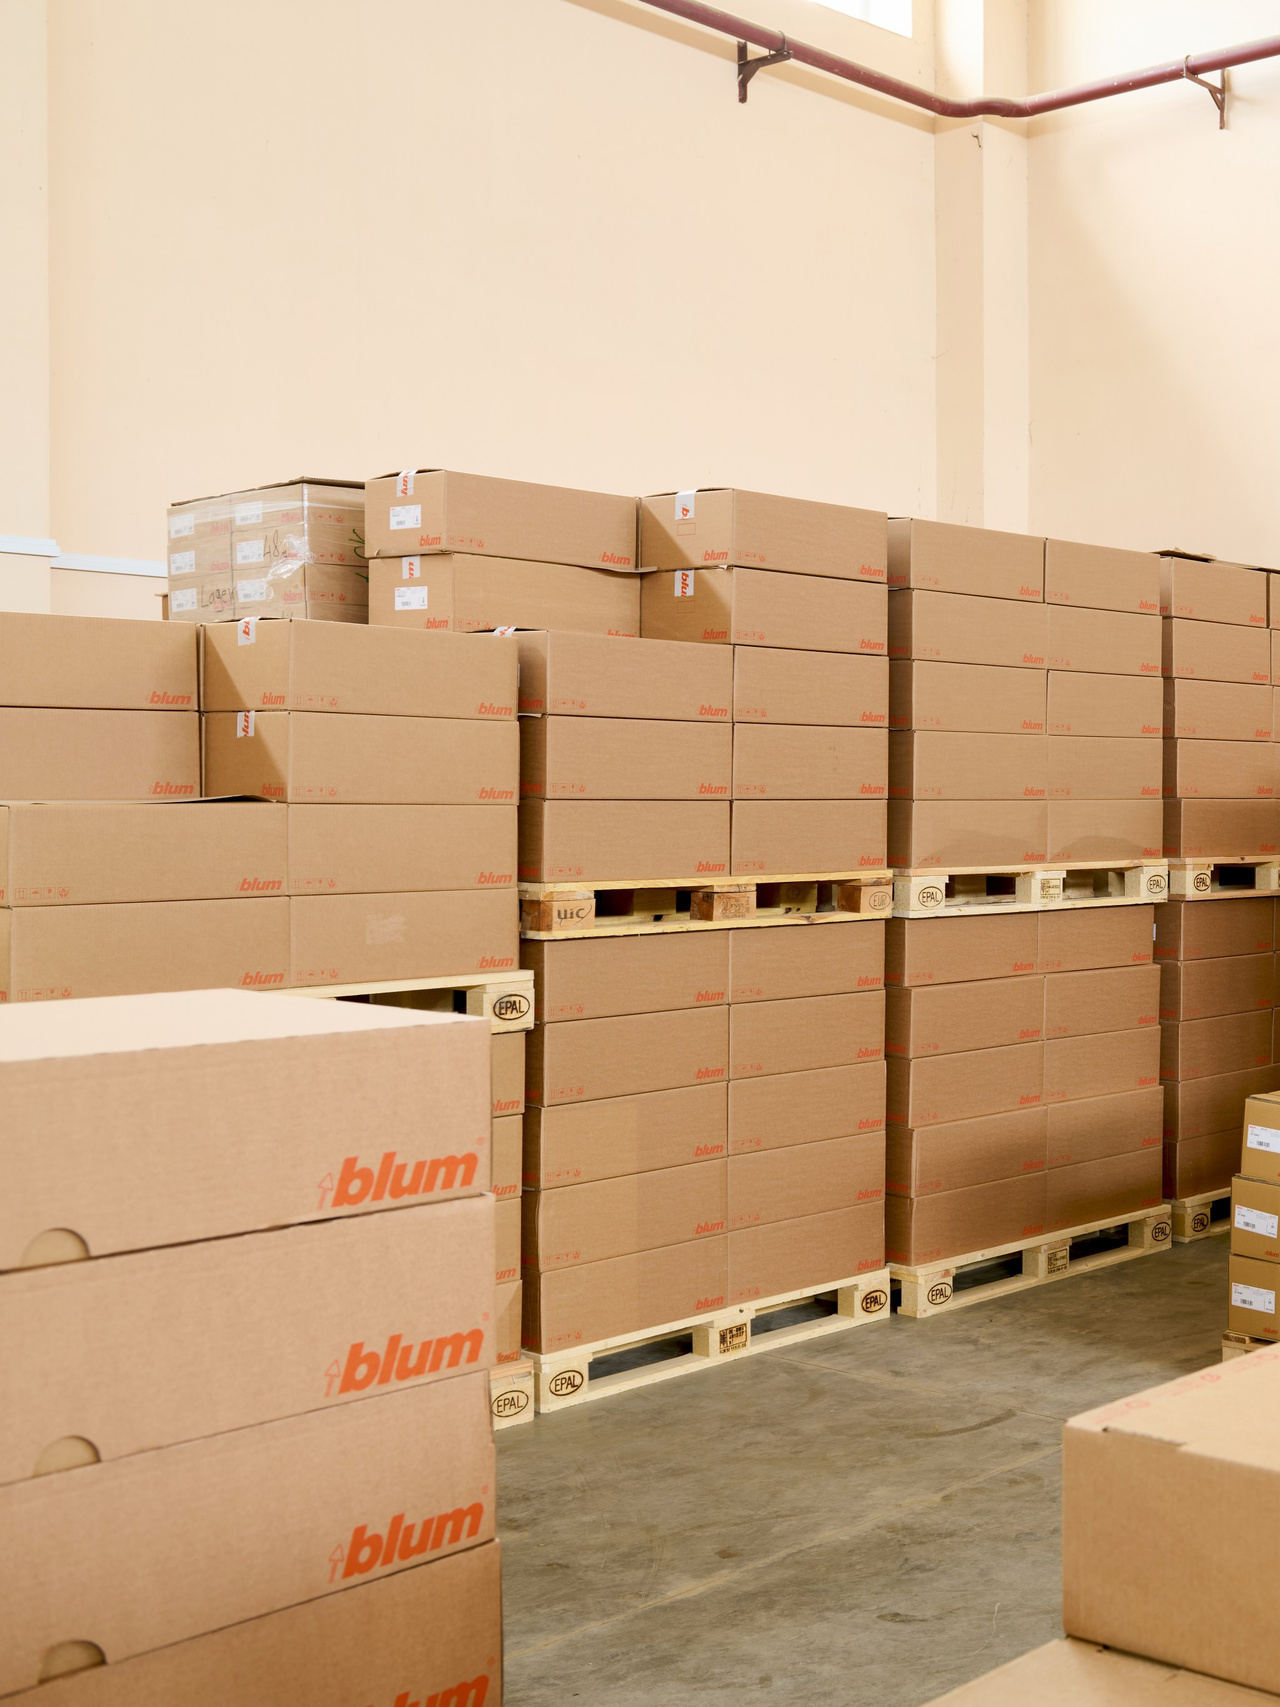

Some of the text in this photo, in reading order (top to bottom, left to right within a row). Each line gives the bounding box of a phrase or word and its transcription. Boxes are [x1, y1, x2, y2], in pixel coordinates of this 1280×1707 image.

[419, 536, 440, 547] blum
[601, 552, 631, 565] blum
[704, 550, 728, 561] blum
[860, 565, 884, 577] blum
[1020, 587, 1040, 596] blum
[1139, 600, 1157, 610] blum
[425, 618, 448, 629] blum
[702, 629, 727, 640] blum
[860, 639, 884, 650] blum
[1022, 654, 1044, 664] blum
[150, 691, 191, 705] blum
[262, 692, 285, 705] blum
[478, 702, 512, 716] blum
[699, 705, 728, 716] blum
[861, 712, 885, 722] blum
[1022, 720, 1043, 730] blum
[1141, 725, 1160, 734] blum
[152, 782, 194, 795] blum
[261, 784, 283, 796] blum
[479, 788, 514, 799] blum
[699, 783, 728, 794] blum
[860, 784, 884, 794] blum
[1023, 788, 1045, 796] blum
[1141, 787, 1160, 795] blum
[859, 856, 883, 866] blum
[1024, 852, 1045, 861] blum
[696, 861, 725, 872] blum
[477, 872, 512, 884] blum
[1196, 877, 1209, 889] EPAL
[240, 878, 282, 891] blum
[1149, 878, 1165, 891] EPAL
[872, 894, 887, 907] EUR
[922, 890, 940, 904] EPAL
[557, 905, 583, 920] uic
[479, 957, 514, 968] blum
[1012, 962, 1034, 971] blum
[241, 971, 284, 986] blum
[856, 976, 881, 987] blum
[696, 991, 724, 1002] blum
[499, 1000, 524, 1016] EPAL
[1138, 1016, 1157, 1024] blum
[1019, 1030, 1040, 1039] blum
[856, 1048, 881, 1058] blum
[695, 1068, 724, 1079] blum
[1138, 1077, 1157, 1086] blum
[1019, 1095, 1040, 1104] blum
[493, 1100, 520, 1112] lum
[857, 1119, 882, 1130] blum
[1142, 1137, 1160, 1147] blum
[695, 1146, 723, 1156] blum
[1022, 1160, 1044, 1170] blum
[332, 1152, 478, 1208] blum
[490, 1185, 517, 1196] lum
[857, 1189, 881, 1200] blum
[696, 1222, 723, 1233] blum
[1192, 1216, 1207, 1229] EPAL
[1154, 1225, 1168, 1238] EPAL
[857, 1258, 882, 1271] blum
[930, 1286, 949, 1302] EPAL
[695, 1296, 724, 1310] blum
[865, 1294, 883, 1309] EPAL
[338, 1328, 484, 1394] blum
[554, 1375, 577, 1392] EPAL
[496, 1395, 523, 1414] EPAL
[342, 1503, 484, 1577] blum
